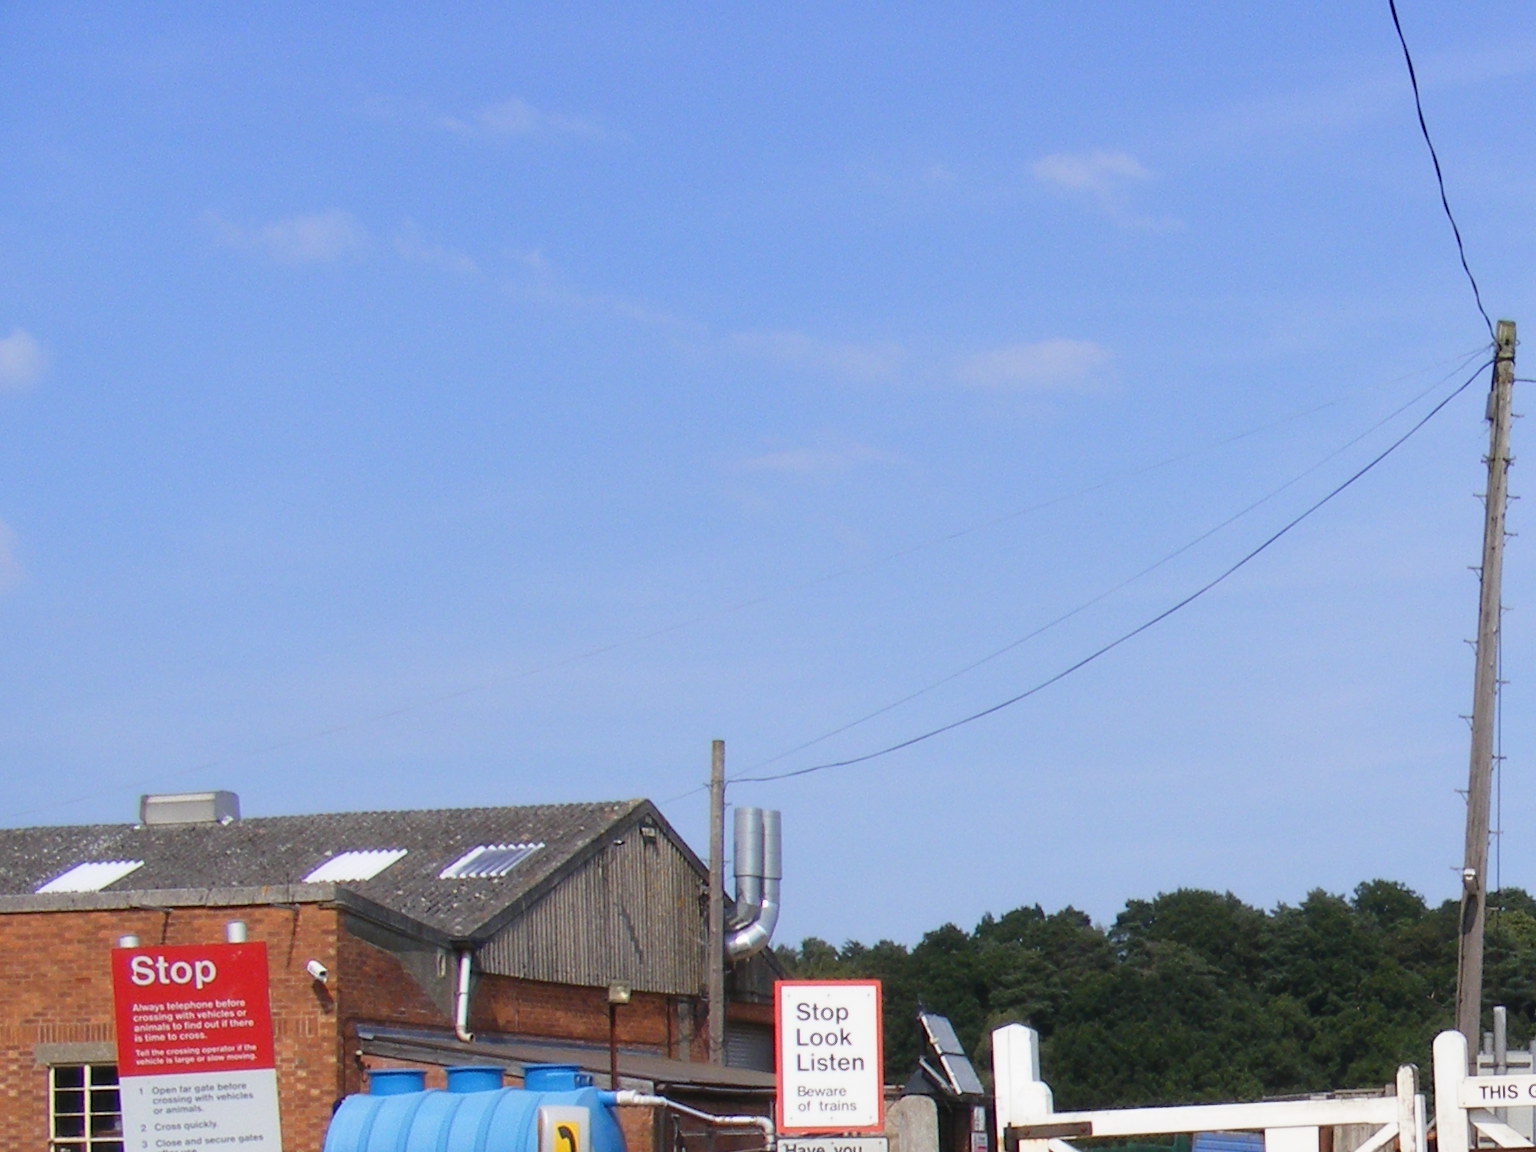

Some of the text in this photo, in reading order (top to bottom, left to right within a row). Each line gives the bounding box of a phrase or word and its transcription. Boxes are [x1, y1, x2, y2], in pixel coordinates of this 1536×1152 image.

[131, 955, 217, 990] Stop
[132, 999, 246, 1013] Always telephone before
[796, 1002, 849, 1024] Stop
[133, 1013, 173, 1023] crossing
[175, 1011, 195, 1020] with
[197, 1009, 235, 1019] vehicles
[134, 1018, 254, 1033] animals to find out if there
[134, 1031, 208, 1043] is time to cross.
[796, 1028, 852, 1047] Look
[135, 1043, 258, 1058] Tell the crossing operator if the
[135, 1052, 257, 1066] vehicle is large or slow moving.
[796, 1053, 865, 1072] Listen
[151, 1085, 177, 1096] Open
[179, 1084, 192, 1094] far
[194, 1084, 215, 1095] gate
[217, 1082, 247, 1092] before
[797, 1085, 847, 1097] Beware
[1479, 1084, 1518, 1100] THIS
[152, 1092, 254, 1106] crossing with vehicles
[797, 1100, 857, 1112] of trains
[153, 1104, 204, 1115] or animals.
[140, 1124, 147, 1132] 2
[154, 1122, 182, 1132] Cross
[142, 1133, 264, 1148] 3 Close and secure gates
